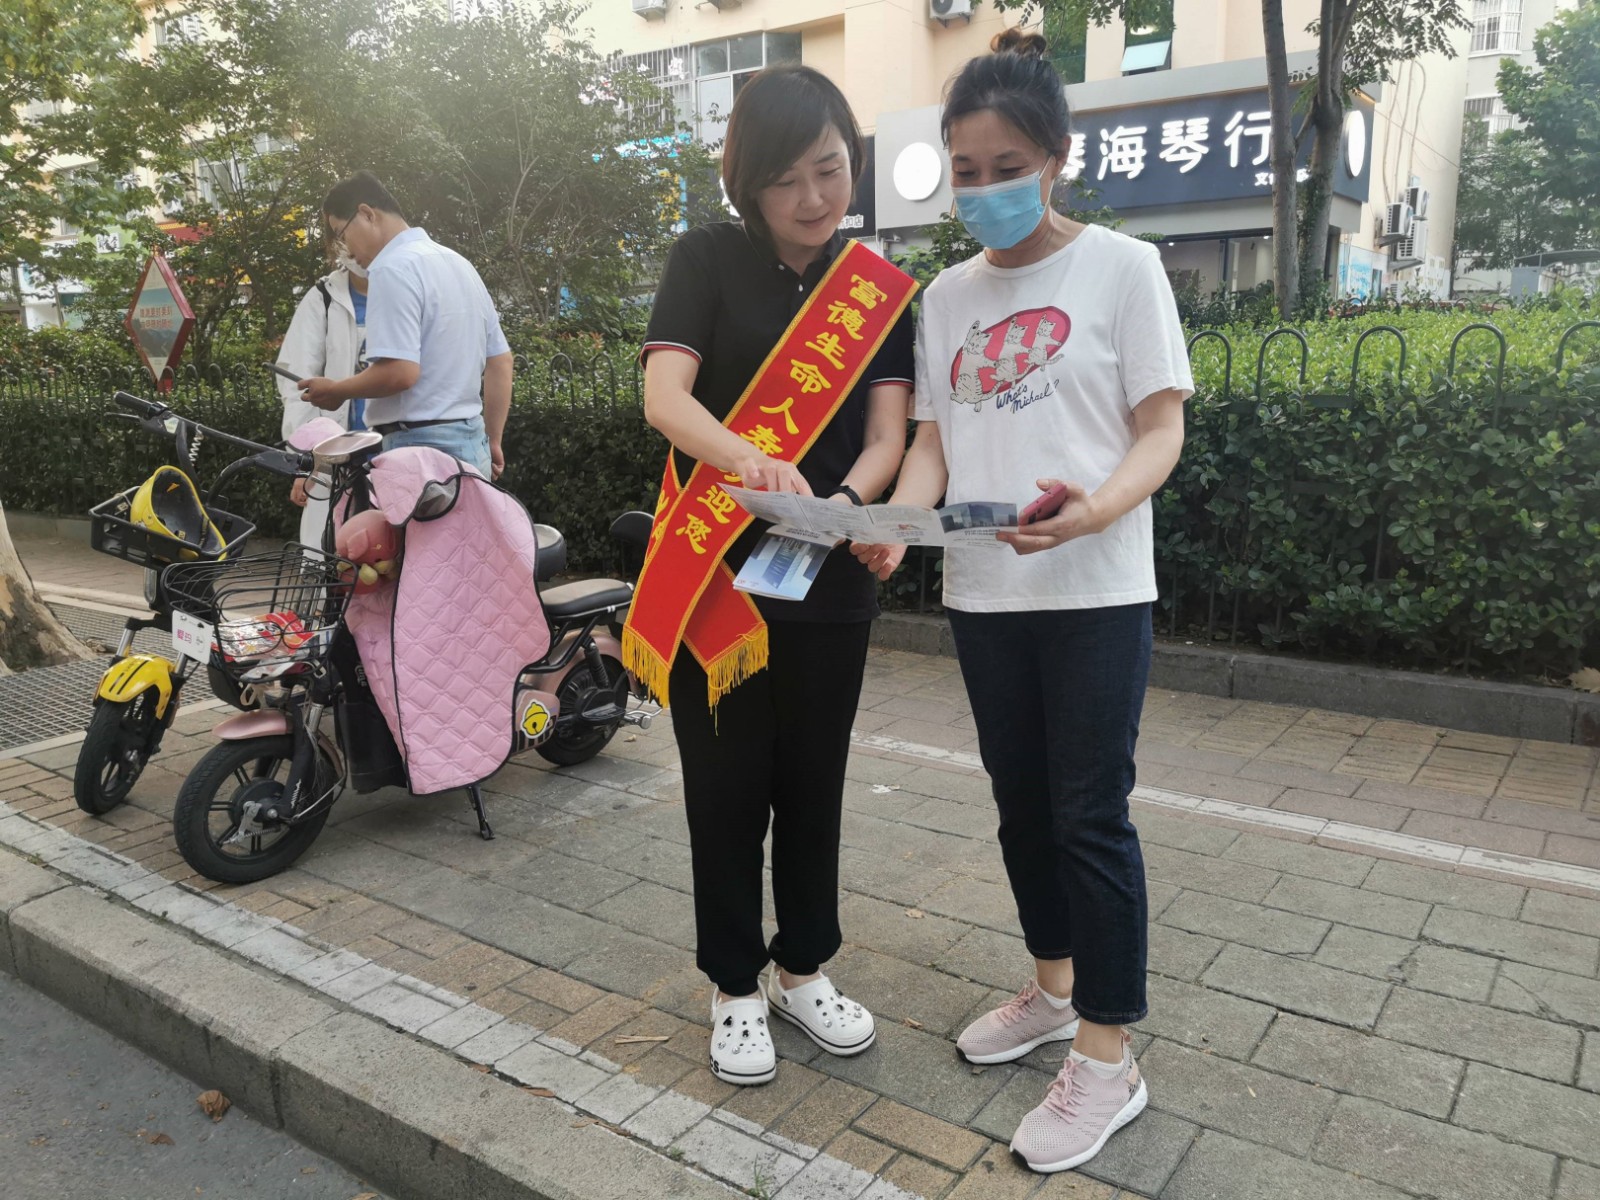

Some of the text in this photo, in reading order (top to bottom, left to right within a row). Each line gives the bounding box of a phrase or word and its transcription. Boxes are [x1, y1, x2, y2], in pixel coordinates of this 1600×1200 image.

[675, 273, 888, 555] 富德生命人寿迎您
[996, 383, 1028, 410] What's
